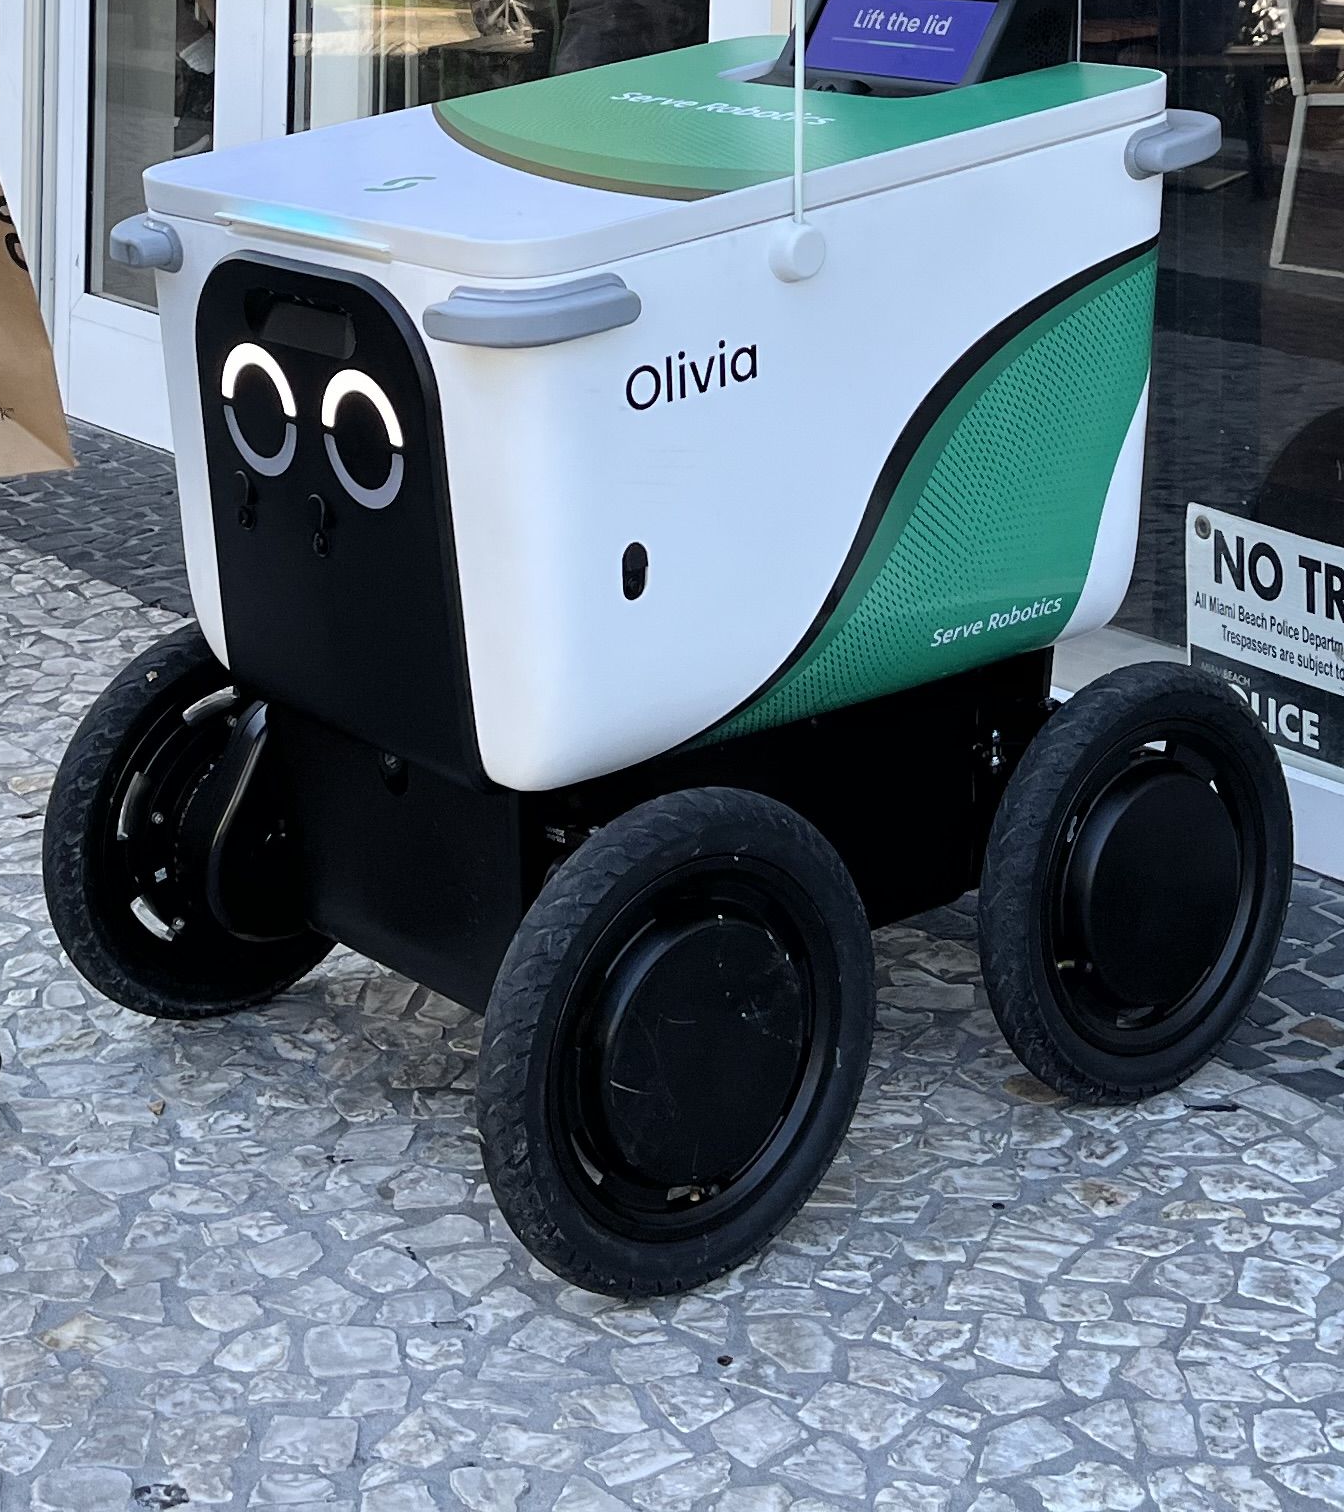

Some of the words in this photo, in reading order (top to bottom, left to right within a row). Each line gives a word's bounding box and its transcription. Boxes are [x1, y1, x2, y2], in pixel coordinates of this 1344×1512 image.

[853, 8, 886, 31] Lift
[886, 12, 921, 33] the
[922, 14, 953, 36] lid
[610, 91, 699, 109] Serve
[625, 339, 758, 411] Olivia
[1213, 529, 1283, 602] NO
[930, 619, 984, 648] Serve
[986, 596, 1063, 632] Robotics
[1194, 590, 1208, 611] All
[1209, 595, 1236, 620] Miami
[1238, 604, 1268, 631] Beach
[1269, 614, 1300, 641] Police
[1221, 624, 1278, 660] Trespassers
[1279, 647, 1295, 665] are
[1297, 653, 1334, 682] subject
